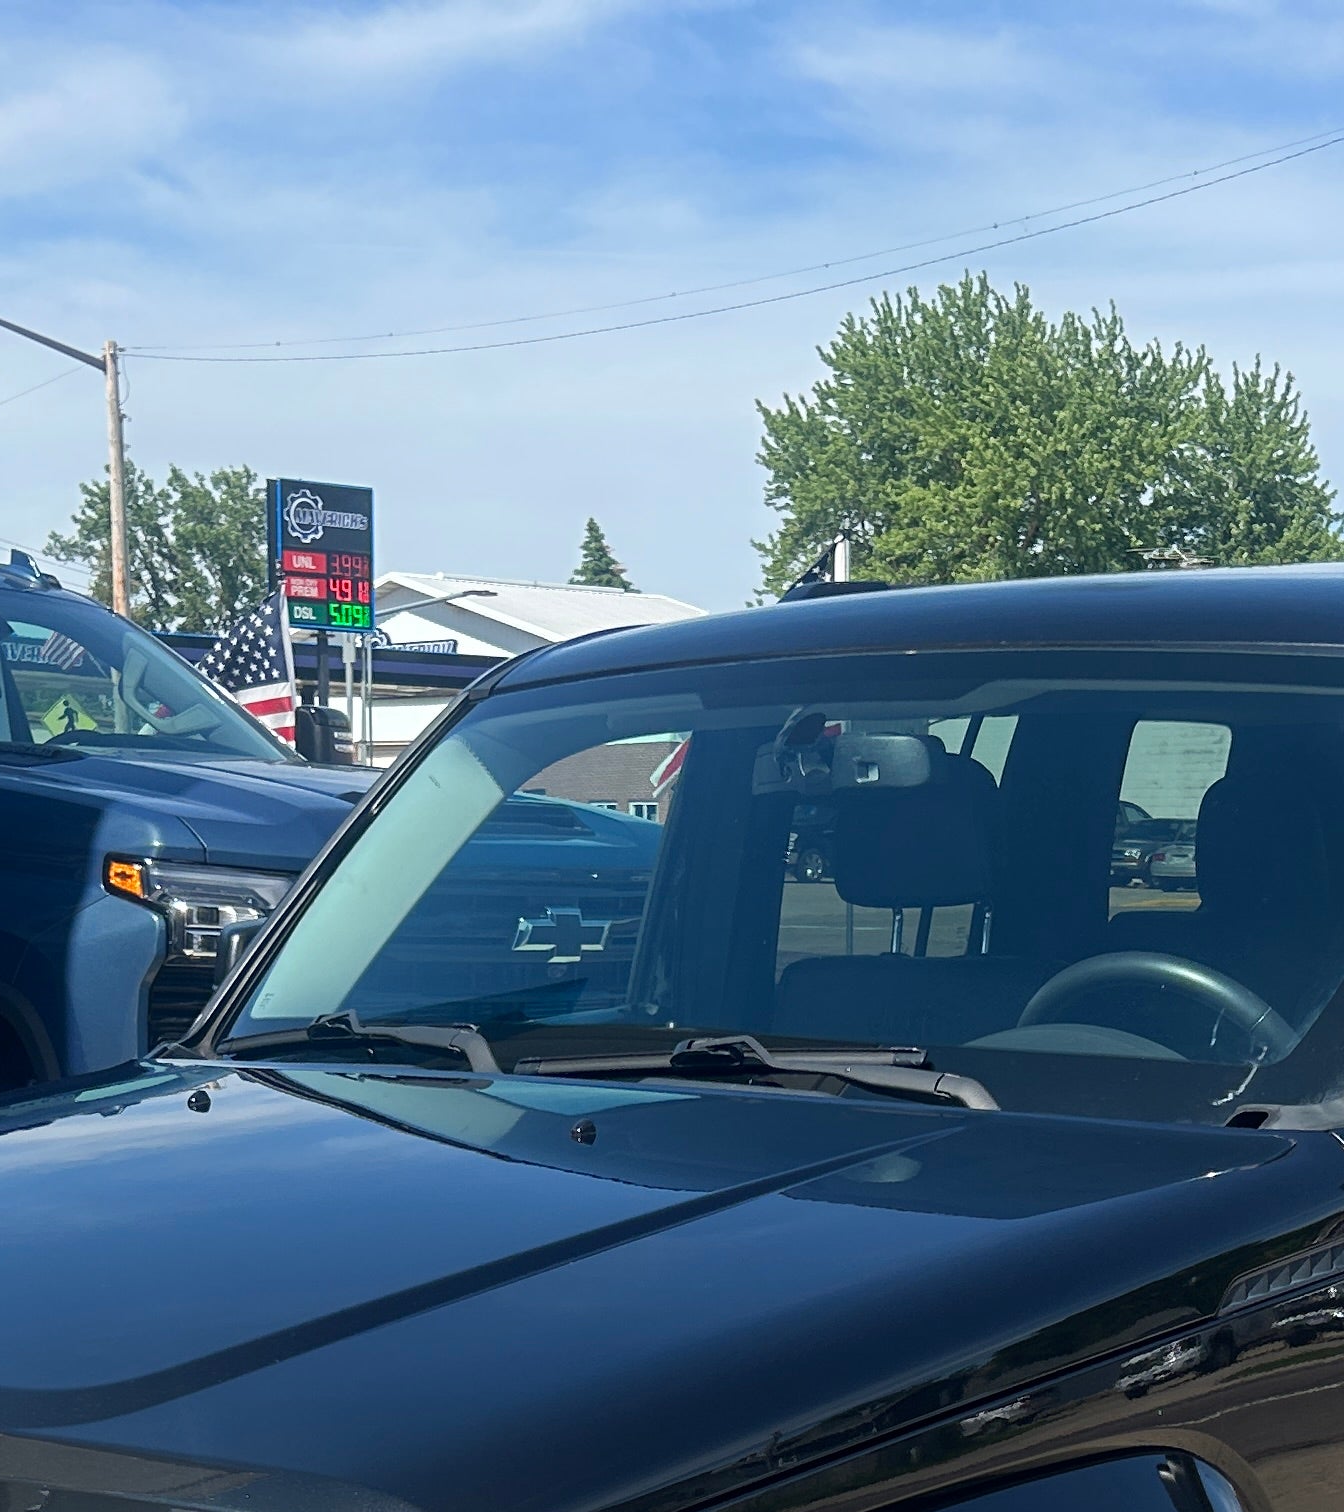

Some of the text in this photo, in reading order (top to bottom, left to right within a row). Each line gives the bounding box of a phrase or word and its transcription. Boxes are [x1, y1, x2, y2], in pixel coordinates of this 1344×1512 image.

[292, 555, 316, 570] UNL
[291, 585, 318, 597] PREM
[293, 606, 317, 620] DSL
